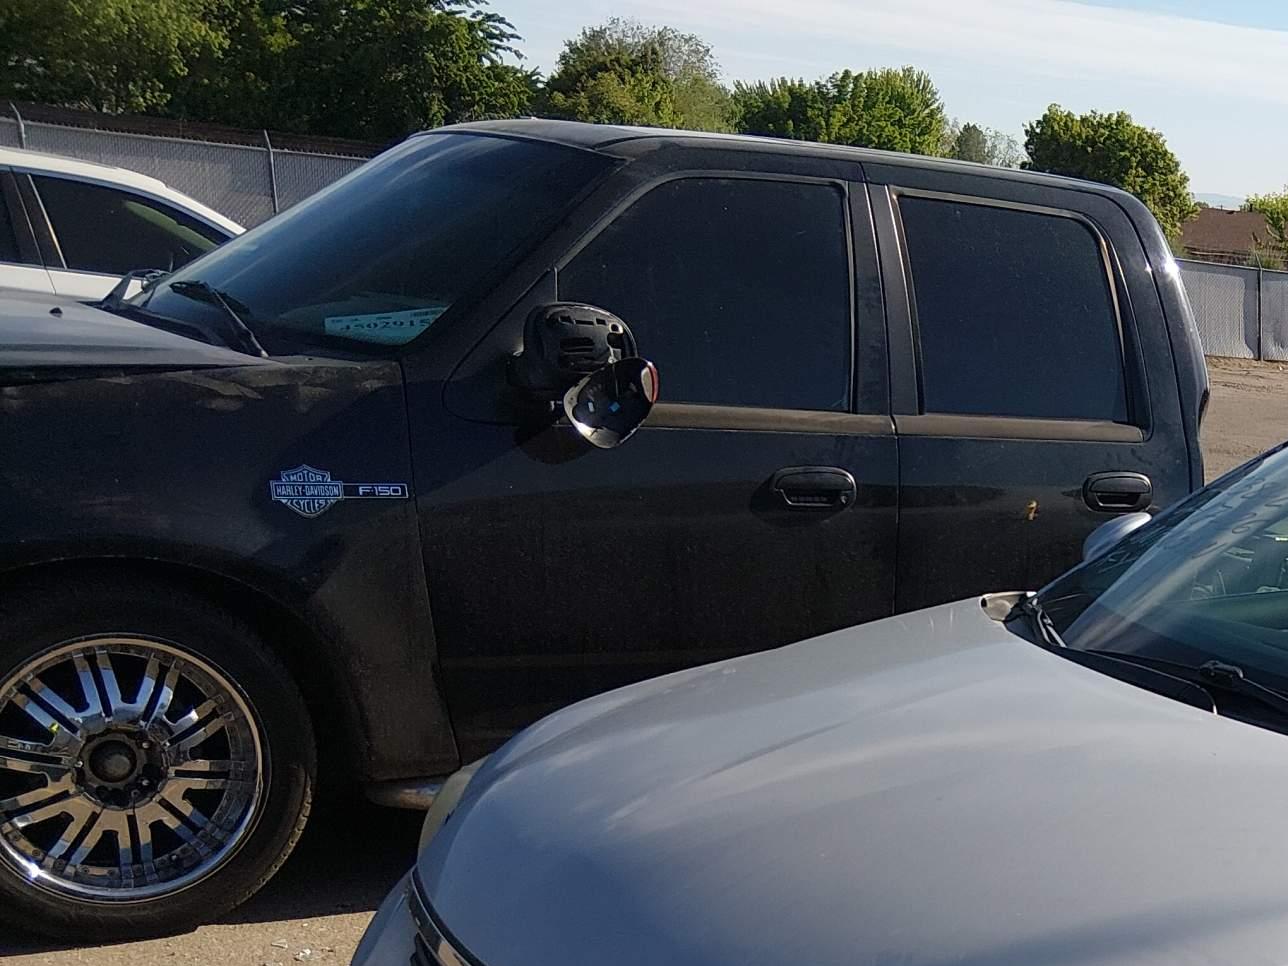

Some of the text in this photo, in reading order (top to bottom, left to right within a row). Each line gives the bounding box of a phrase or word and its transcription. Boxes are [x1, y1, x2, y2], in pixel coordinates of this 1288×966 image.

[290, 470, 323, 482] MOTOR
[276, 485, 339, 496] HARLEY-DAVIDSON
[359, 486, 402, 496] F-150
[293, 499, 326, 513] CYCLES
